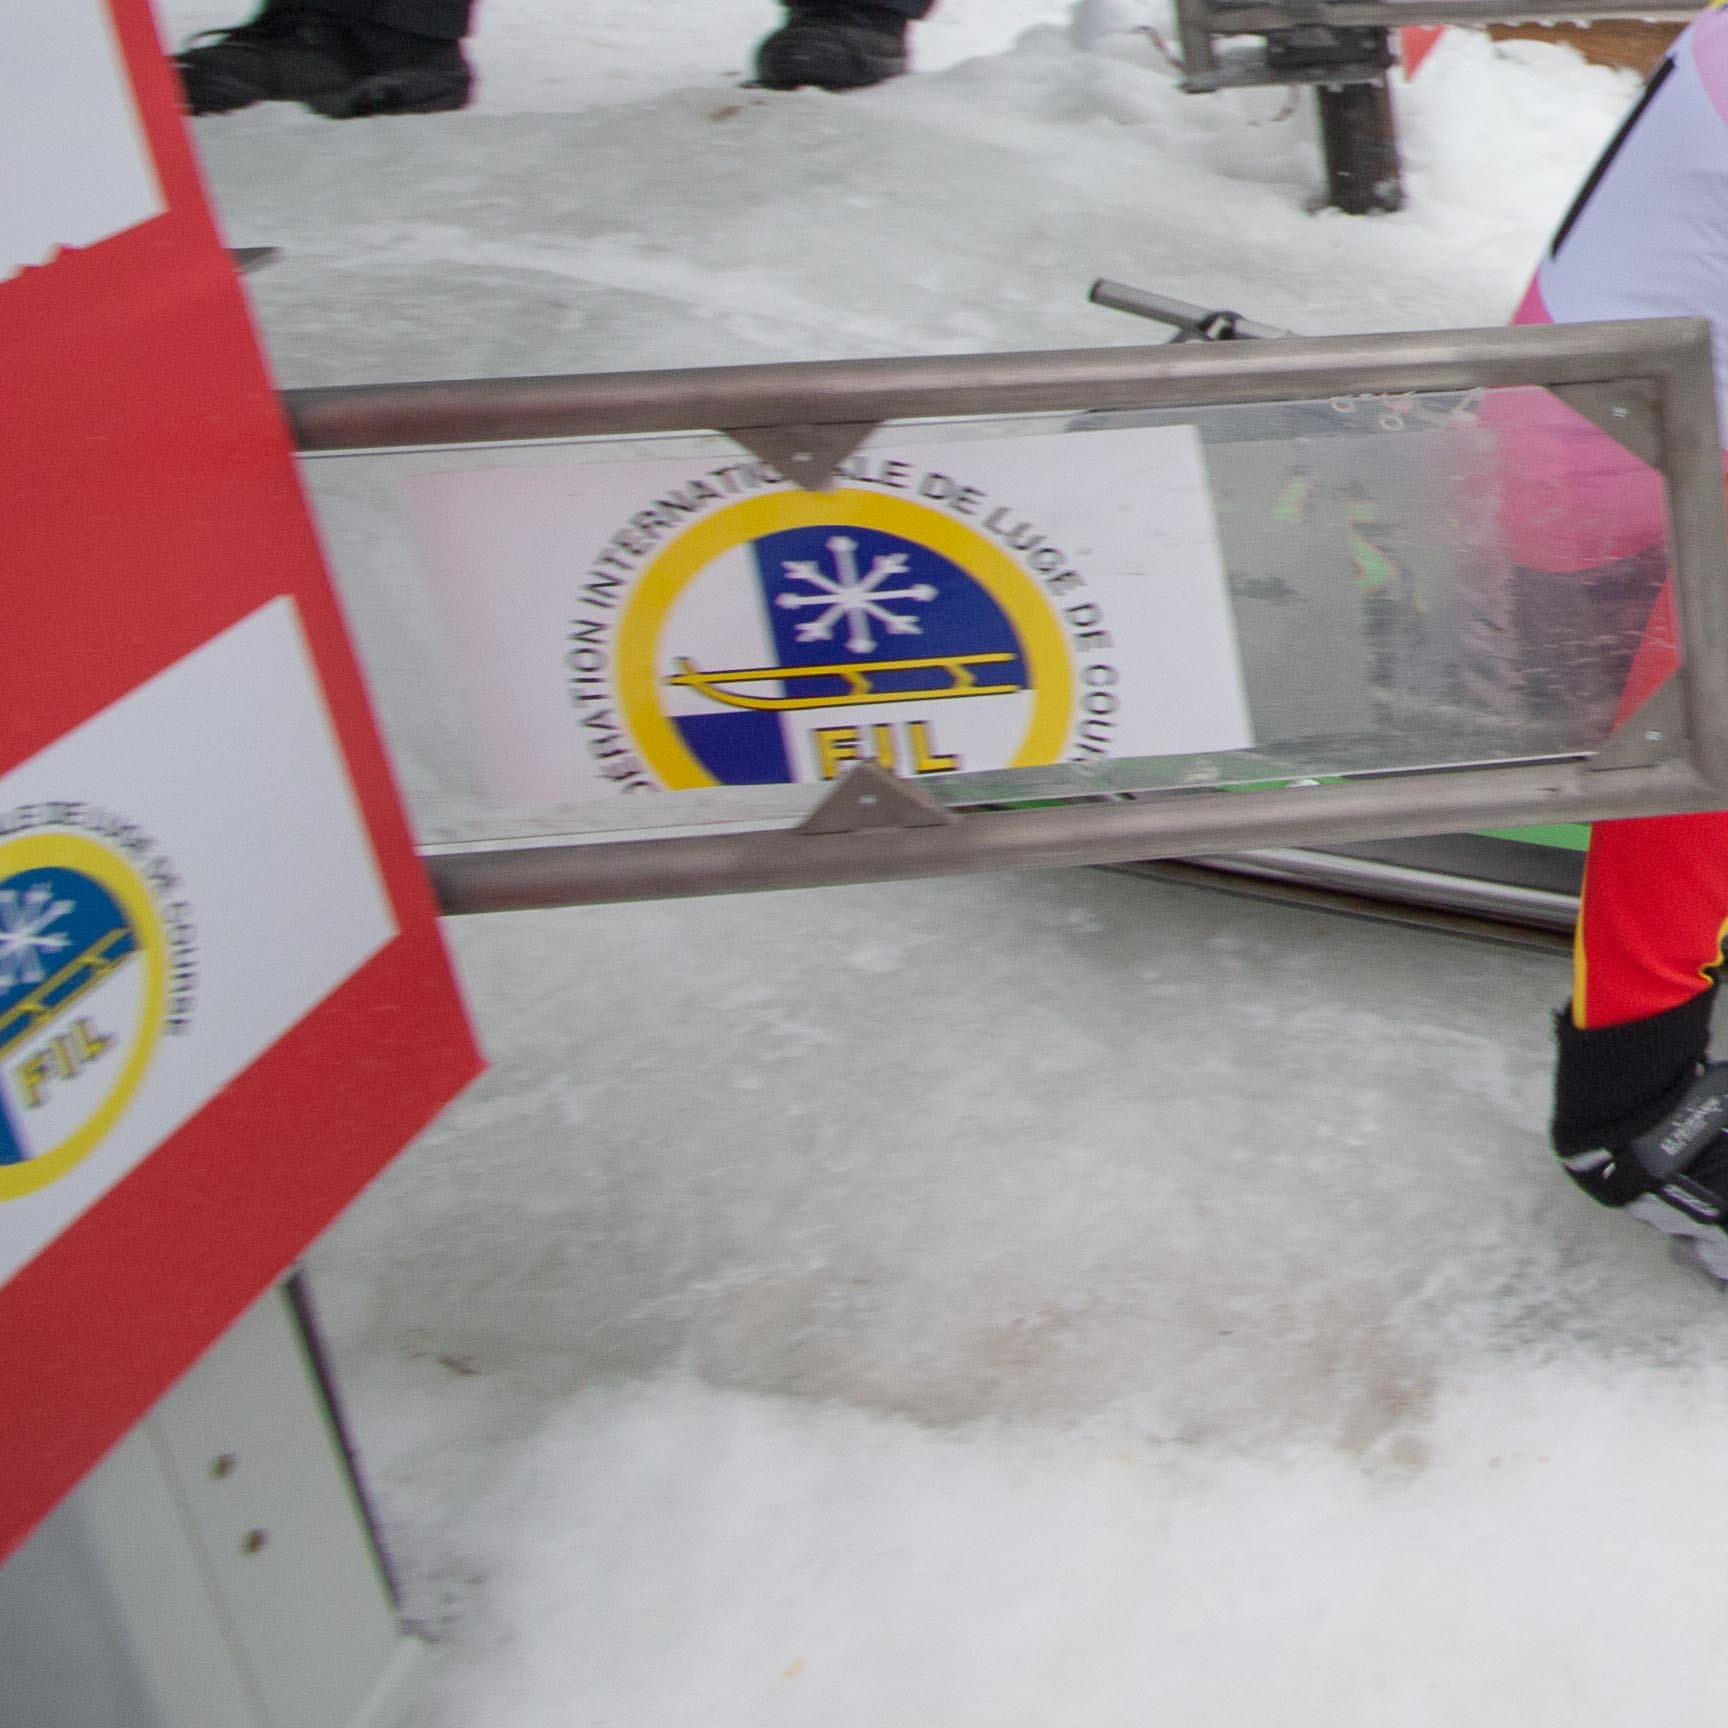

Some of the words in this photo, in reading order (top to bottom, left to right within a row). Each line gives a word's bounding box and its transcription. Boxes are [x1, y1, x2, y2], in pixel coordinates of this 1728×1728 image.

[917, 472, 988, 515] DE
[983, 506, 1086, 597] LUGE
[811, 720, 962, 782] FIL
[15, 1016, 119, 1111] FIL
